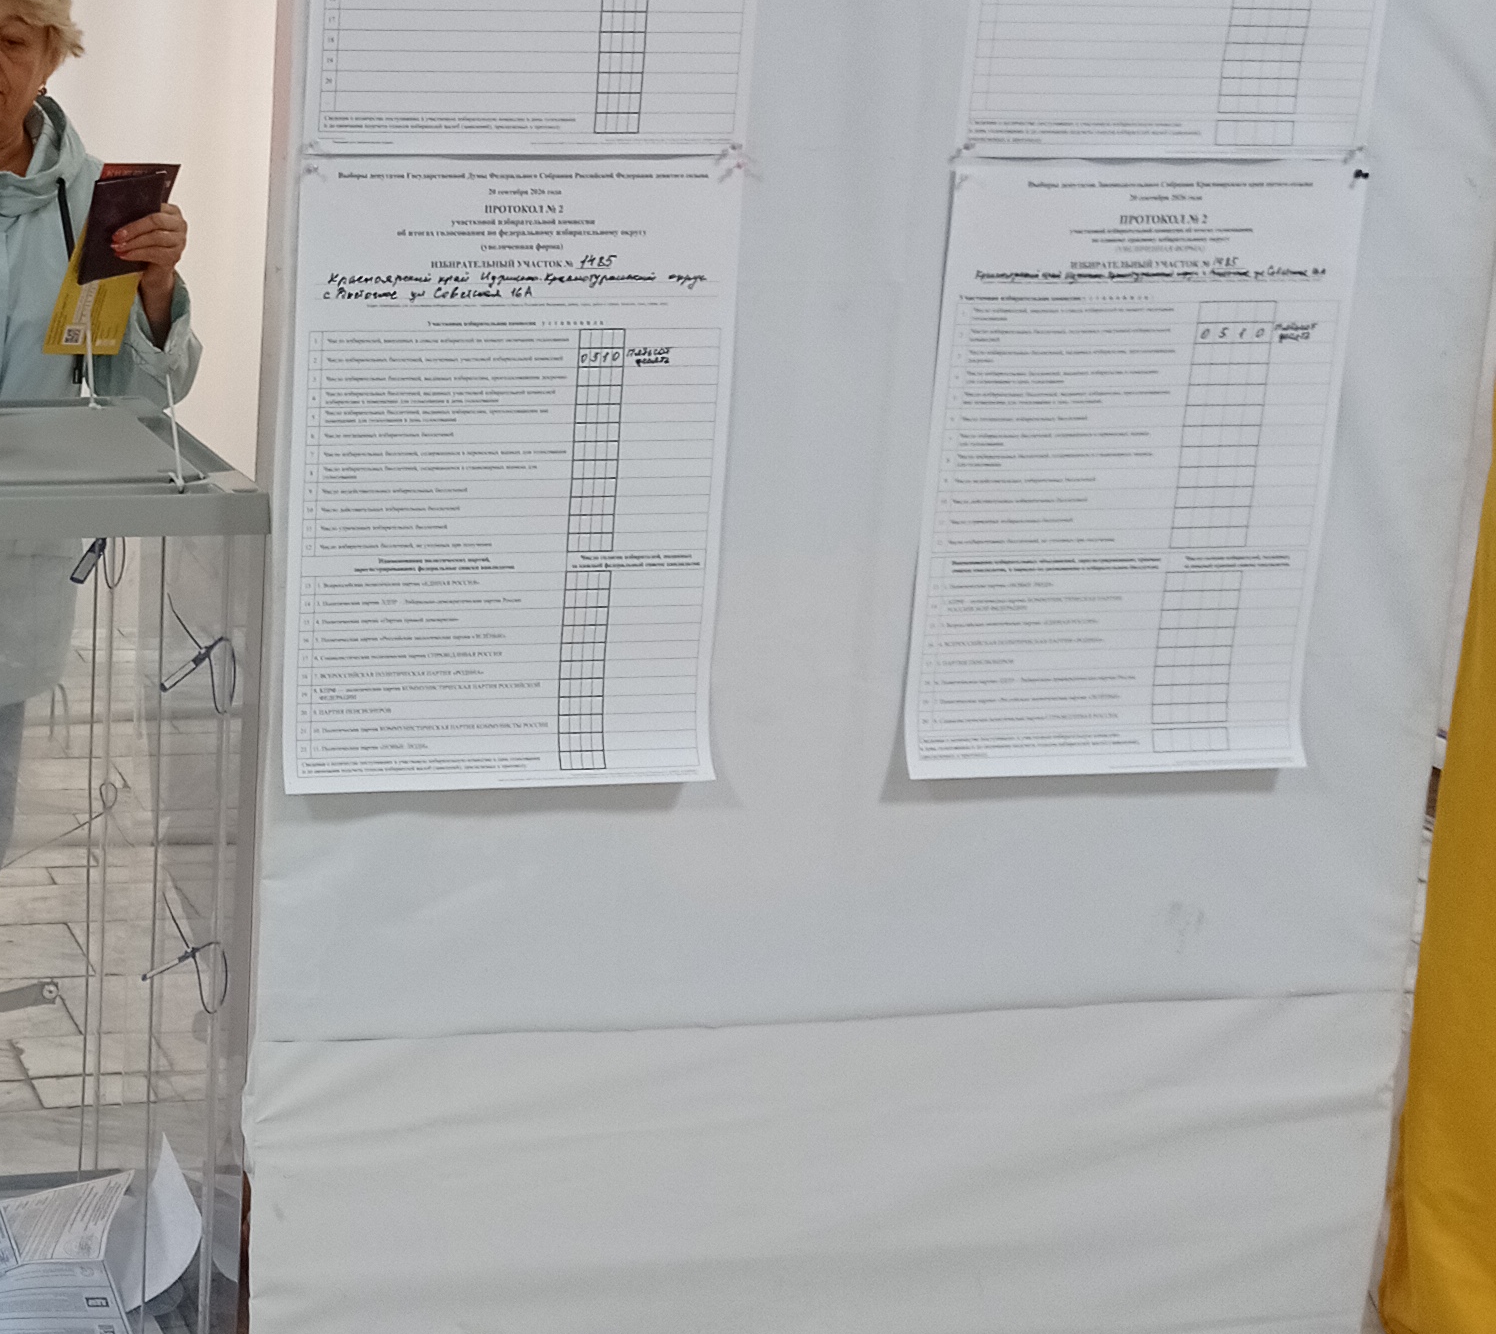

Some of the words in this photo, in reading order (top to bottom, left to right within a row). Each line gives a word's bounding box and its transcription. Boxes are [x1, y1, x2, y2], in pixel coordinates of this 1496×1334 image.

[485, 205, 543, 214] ПРОТОКОЛ
[558, 205, 564, 214] 2
[1120, 214, 1185, 224] ПРОТОКОЛ
[1201, 214, 1208, 224] 2
[431, 260, 515, 269] ИЗБИРАТЕЛЬНЫЙ
[517, 260, 562, 268] УЧАСТОК
